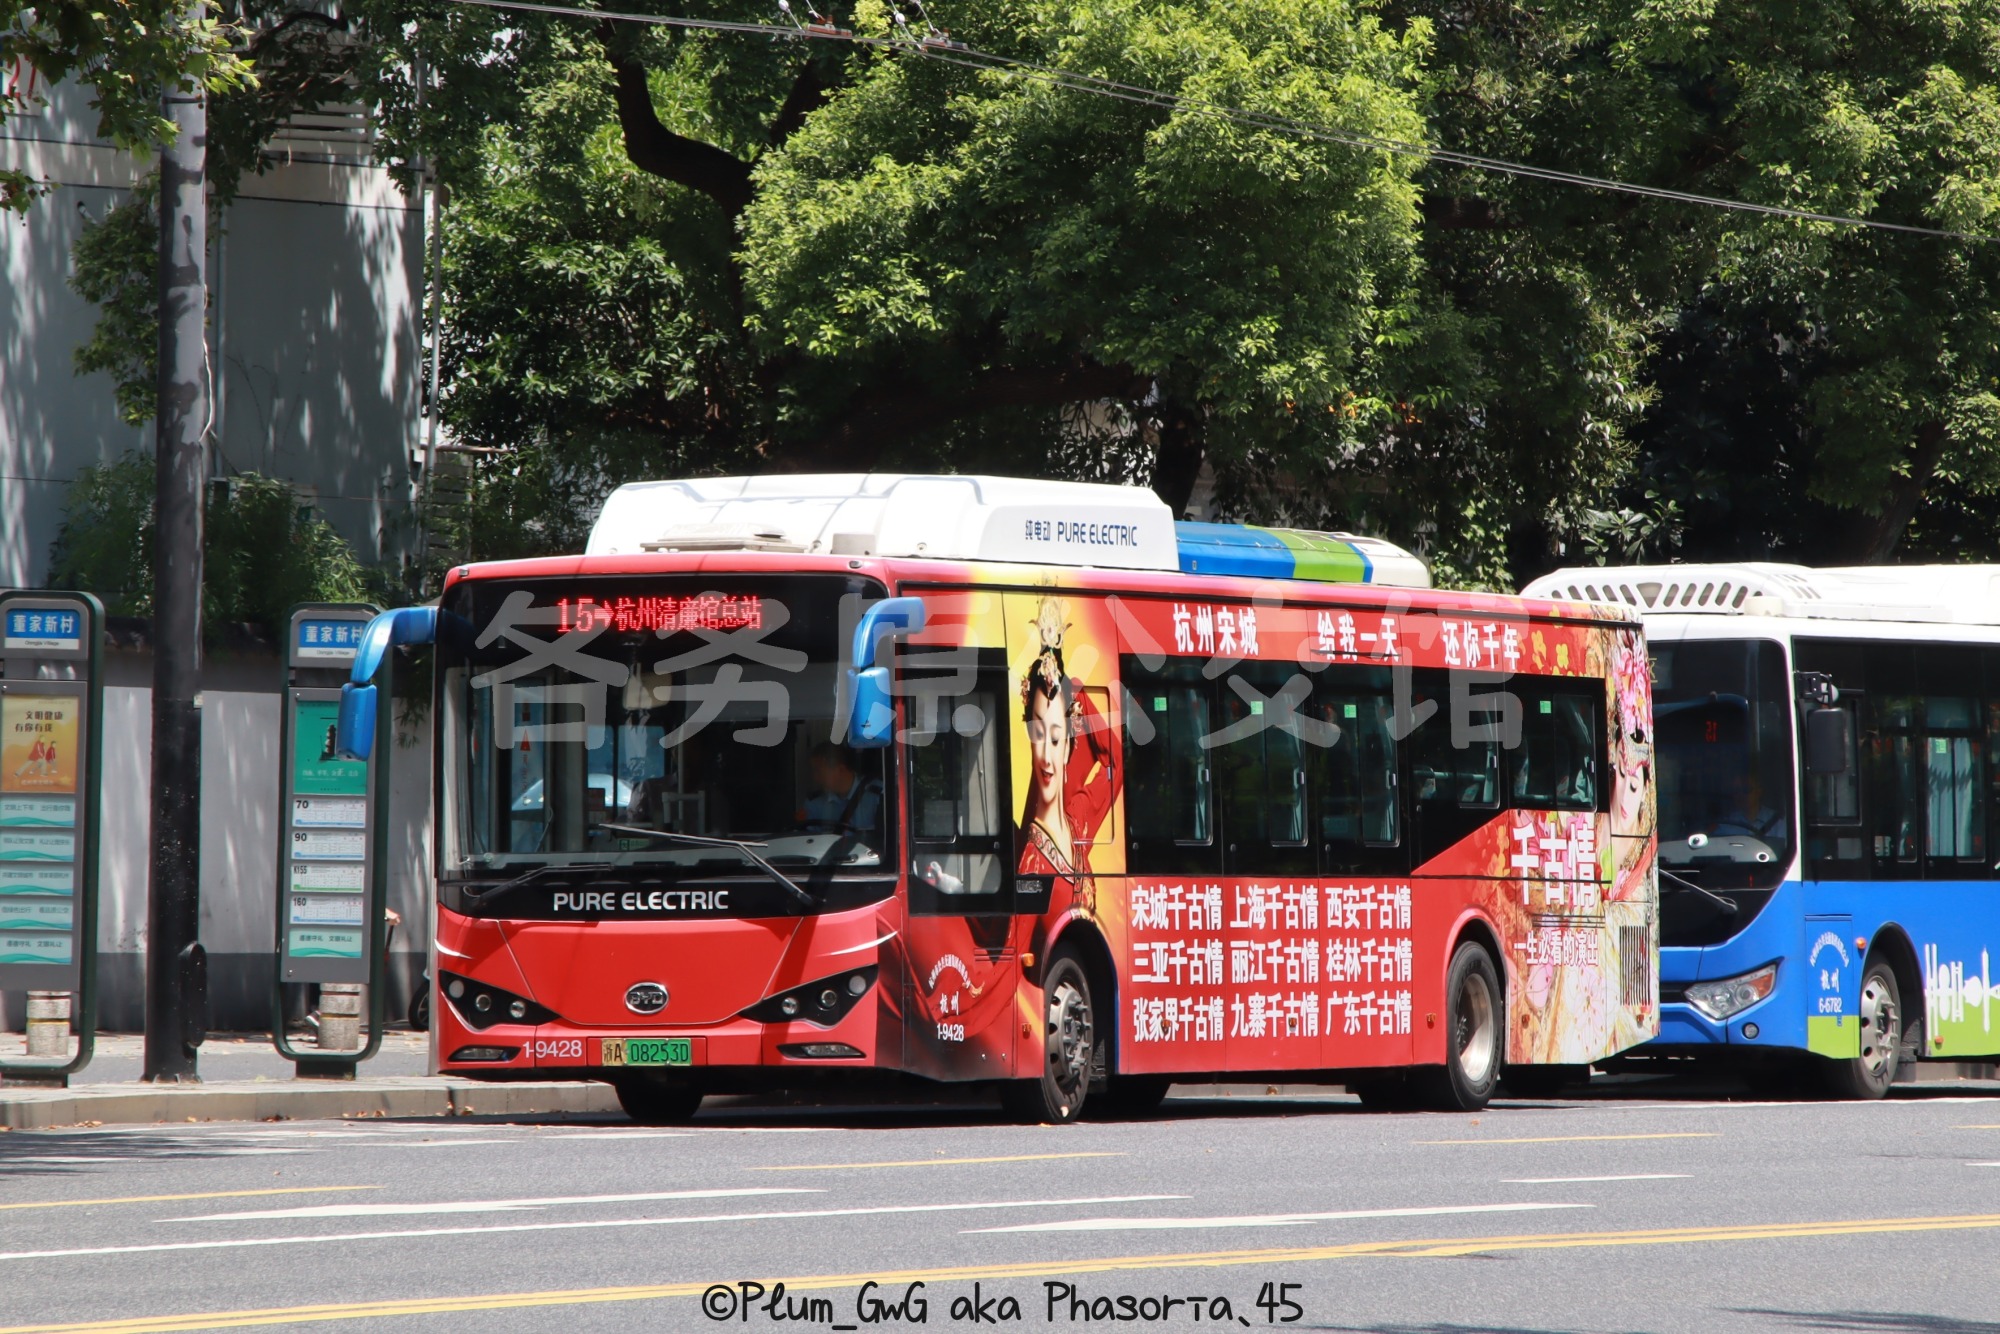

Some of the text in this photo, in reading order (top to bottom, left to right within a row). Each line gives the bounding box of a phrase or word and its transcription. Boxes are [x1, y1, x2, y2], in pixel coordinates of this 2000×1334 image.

[1025, 520, 1138, 547] 纯电动 PURE ELECTRIC
[13, 614, 75, 633] 董家新村
[557, 596, 763, 632] 15 杭州清廉馆总站
[1173, 603, 1521, 670] 杭州宋城 给我一天 还你千年
[296, 800, 309, 809] 70
[294, 833, 307, 841] 90
[293, 865, 307, 874] K155
[1511, 822, 1597, 907] 千古情
[293, 897, 307, 906] 160
[553, 891, 729, 911] PURE ELECTRIC
[1131, 884, 1412, 931] 宋城千古情 上海千古情 西安千古情
[1514, 929, 1599, 966] 一生必看的演出
[1131, 937, 1412, 985] 三亚千古情 丽江千古情 桂林千古情
[630, 991, 663, 1005] BYD
[1819, 998, 1842, 1013] 6-6782
[1132, 990, 1412, 1042] 张家界千古情 九寨千古情 广东千古情
[937, 1023, 965, 1042] 1-9428
[523, 1040, 582, 1058] 1-9428
[631, 1043, 689, 1062] 08253D
